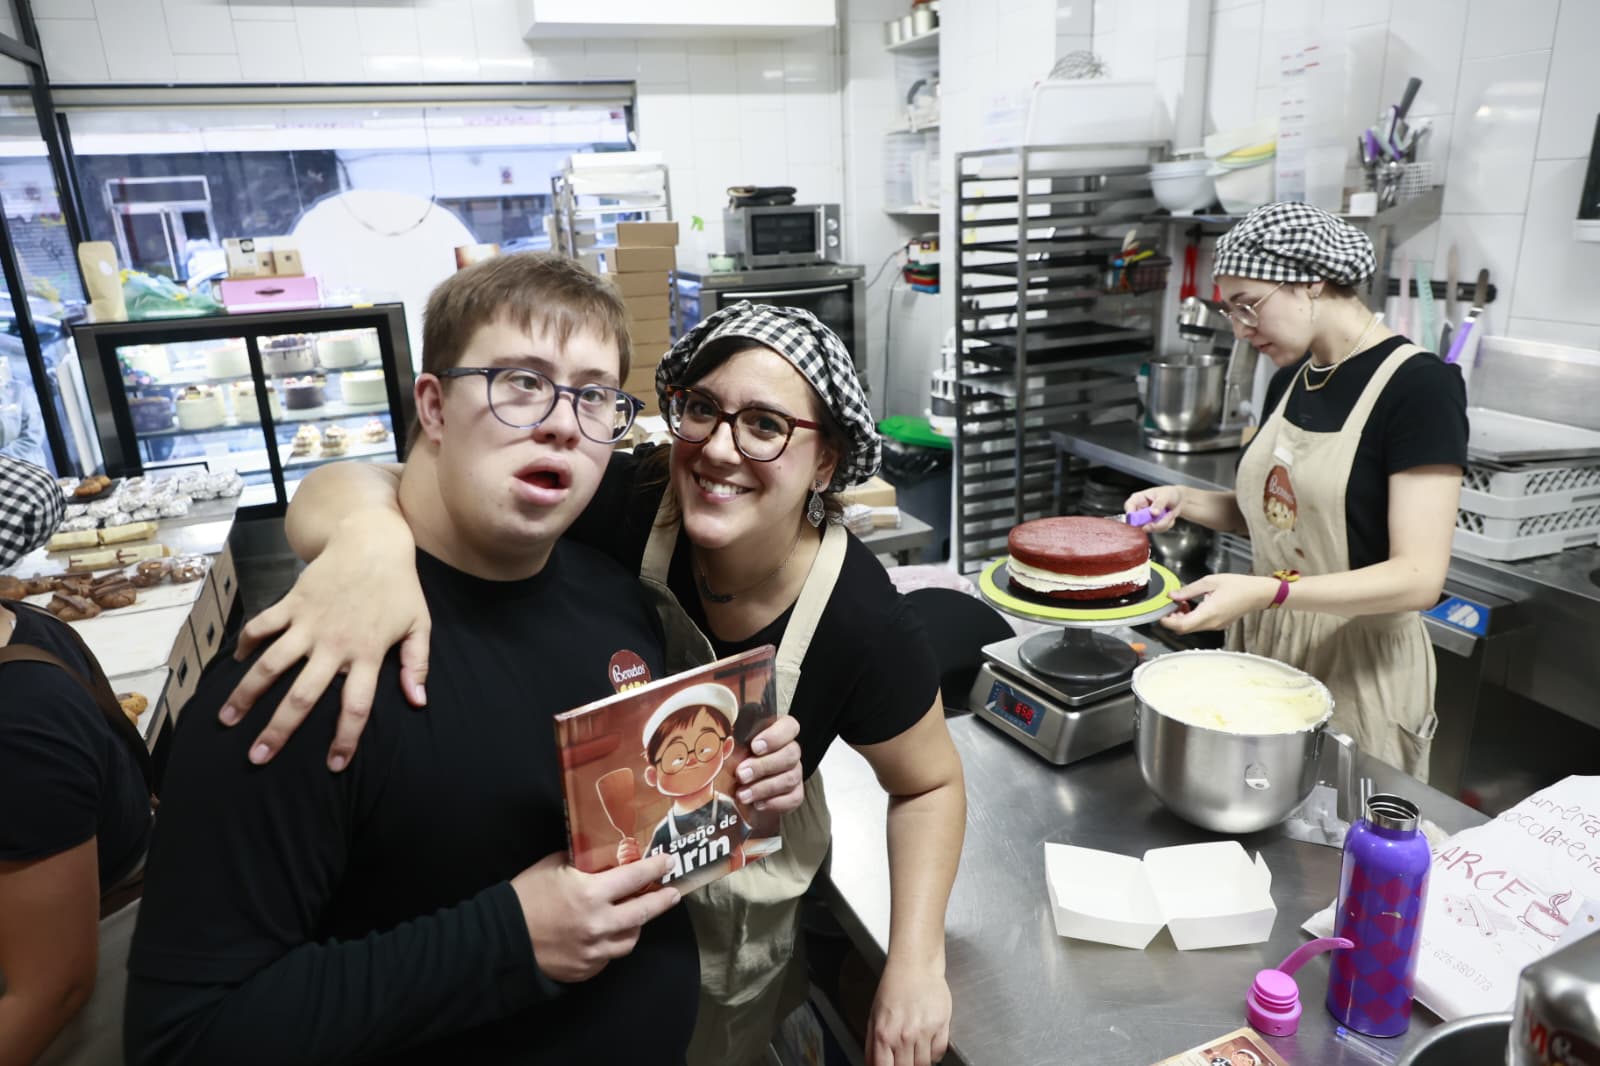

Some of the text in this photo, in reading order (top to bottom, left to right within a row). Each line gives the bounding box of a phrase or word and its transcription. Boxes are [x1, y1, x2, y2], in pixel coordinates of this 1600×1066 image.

[669, 825, 716, 853] sueño
[719, 814, 738, 829] de
[662, 835, 731, 884] Arín
